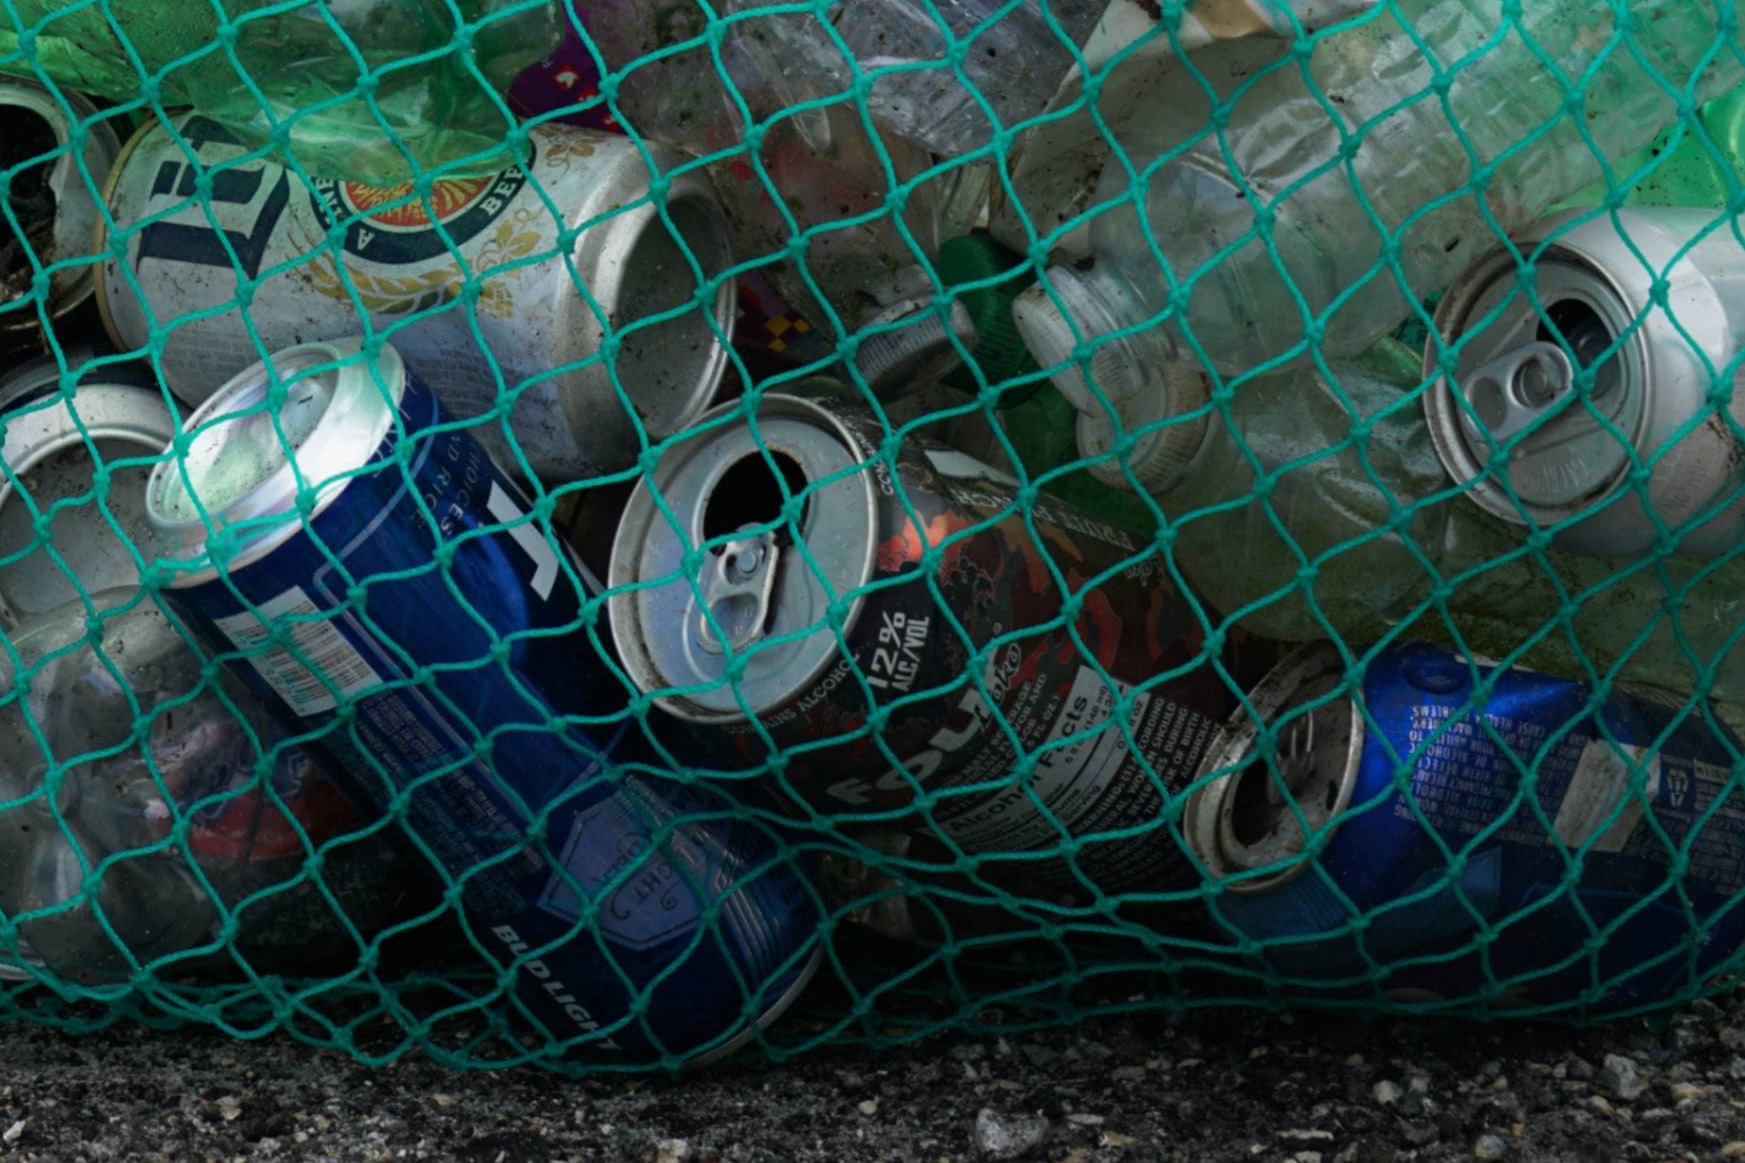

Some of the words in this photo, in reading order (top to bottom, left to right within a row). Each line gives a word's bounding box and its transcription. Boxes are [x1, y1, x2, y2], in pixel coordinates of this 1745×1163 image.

[863, 610, 907, 688] 12%
[890, 613, 931, 692] ALC/VOL
[1149, 700, 1178, 749] SHOULD
[1170, 746, 1185, 765] OF
[489, 917, 554, 984] BUD
[540, 972, 623, 1058] LIGHT
